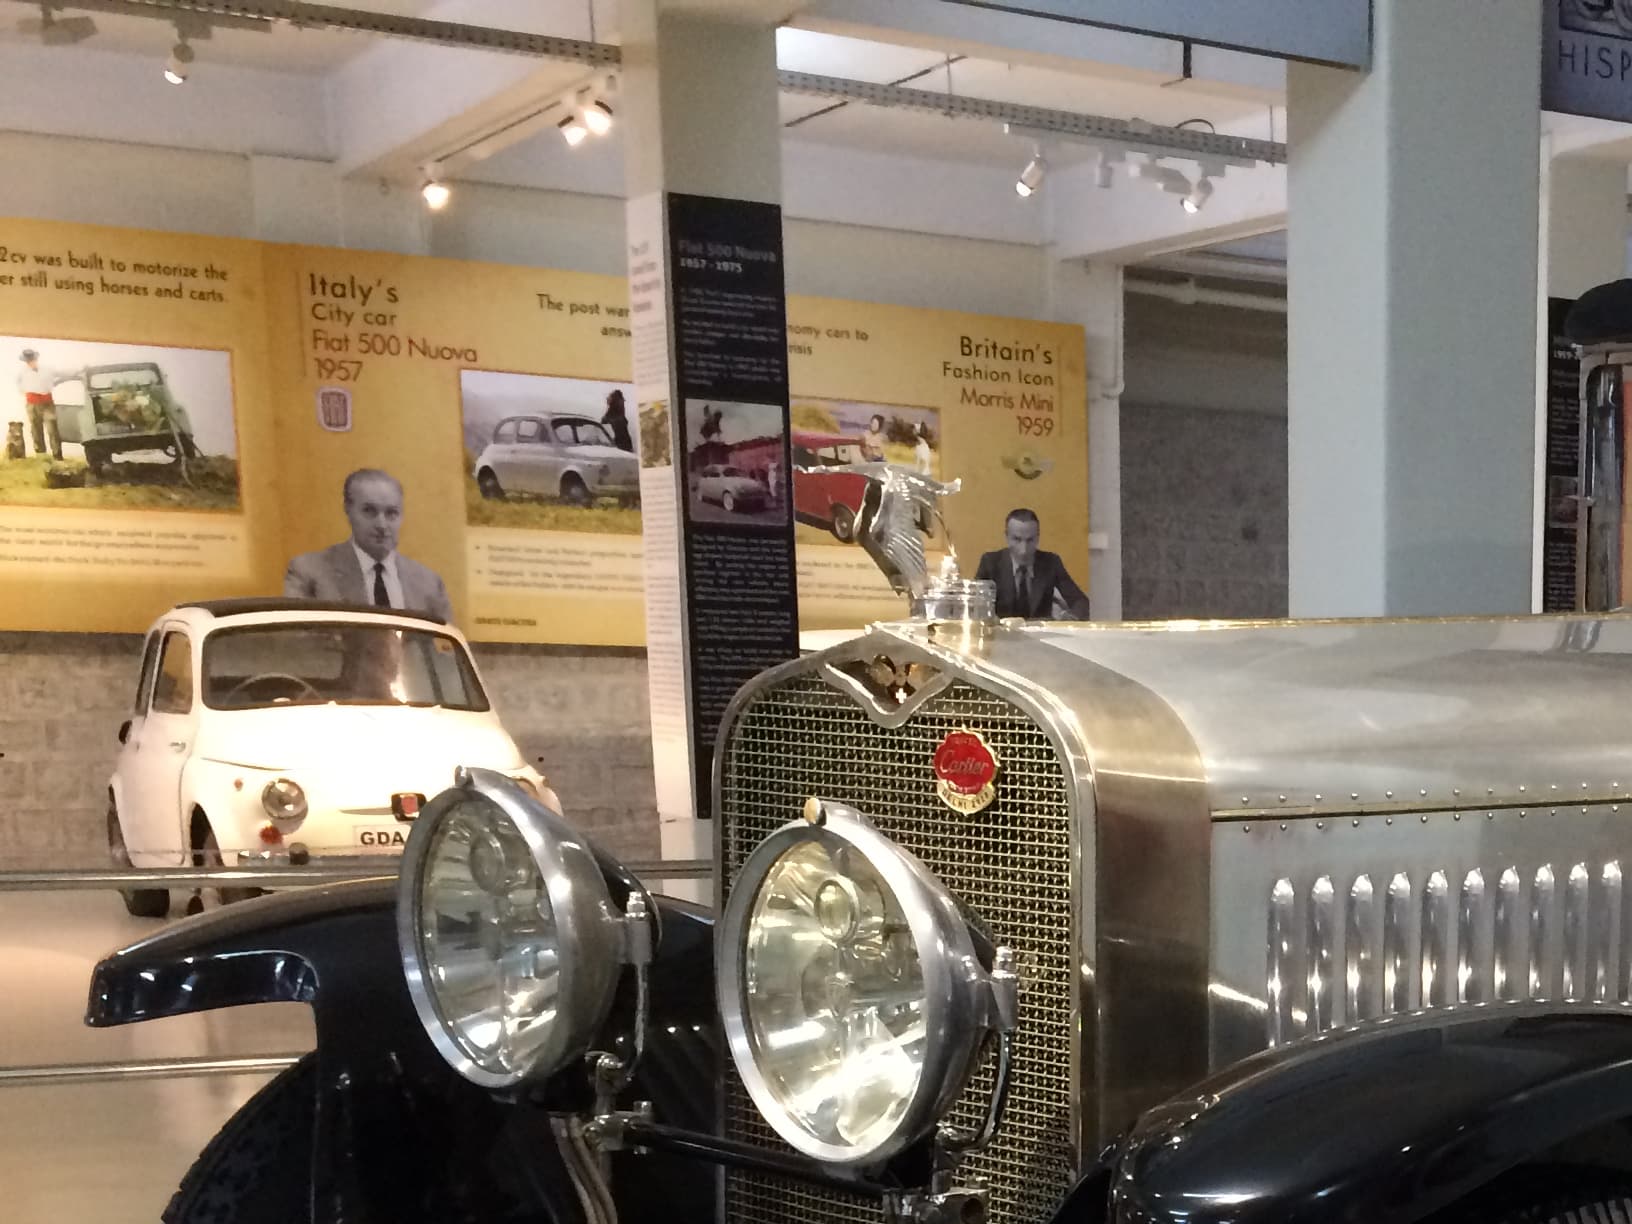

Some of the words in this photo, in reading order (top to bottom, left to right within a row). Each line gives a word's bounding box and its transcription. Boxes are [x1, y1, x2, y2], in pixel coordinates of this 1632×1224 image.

[33, 254, 62, 267] was
[68, 250, 104, 270] built
[110, 258, 126, 272] to
[133, 261, 198, 279] motorize
[204, 262, 228, 281] the
[21, 271, 48, 288] still
[55, 278, 94, 295] using
[101, 277, 148, 297] horses
[155, 282, 183, 299] and
[309, 272, 400, 307] Italy's
[311, 303, 354, 327] City
[363, 312, 397, 326] car
[536, 293, 564, 311] The
[570, 303, 600, 316] post
[605, 306, 630, 318] war
[312, 329, 350, 352] Fiat
[358, 332, 401, 356] 500
[408, 336, 478, 363] Nuova
[826, 329, 850, 339] cars
[856, 329, 870, 341] to
[960, 335, 1053, 365] Britain's
[314, 358, 364, 382] 1957
[943, 361, 1011, 383] Fashion
[1018, 365, 1054, 386] Icon
[960, 387, 1015, 412] Morris
[1020, 393, 1054, 413] Mini
[1016, 415, 1055, 437] 1959
[939, 749, 990, 775] Cartier
[360, 831, 405, 846] GDA
